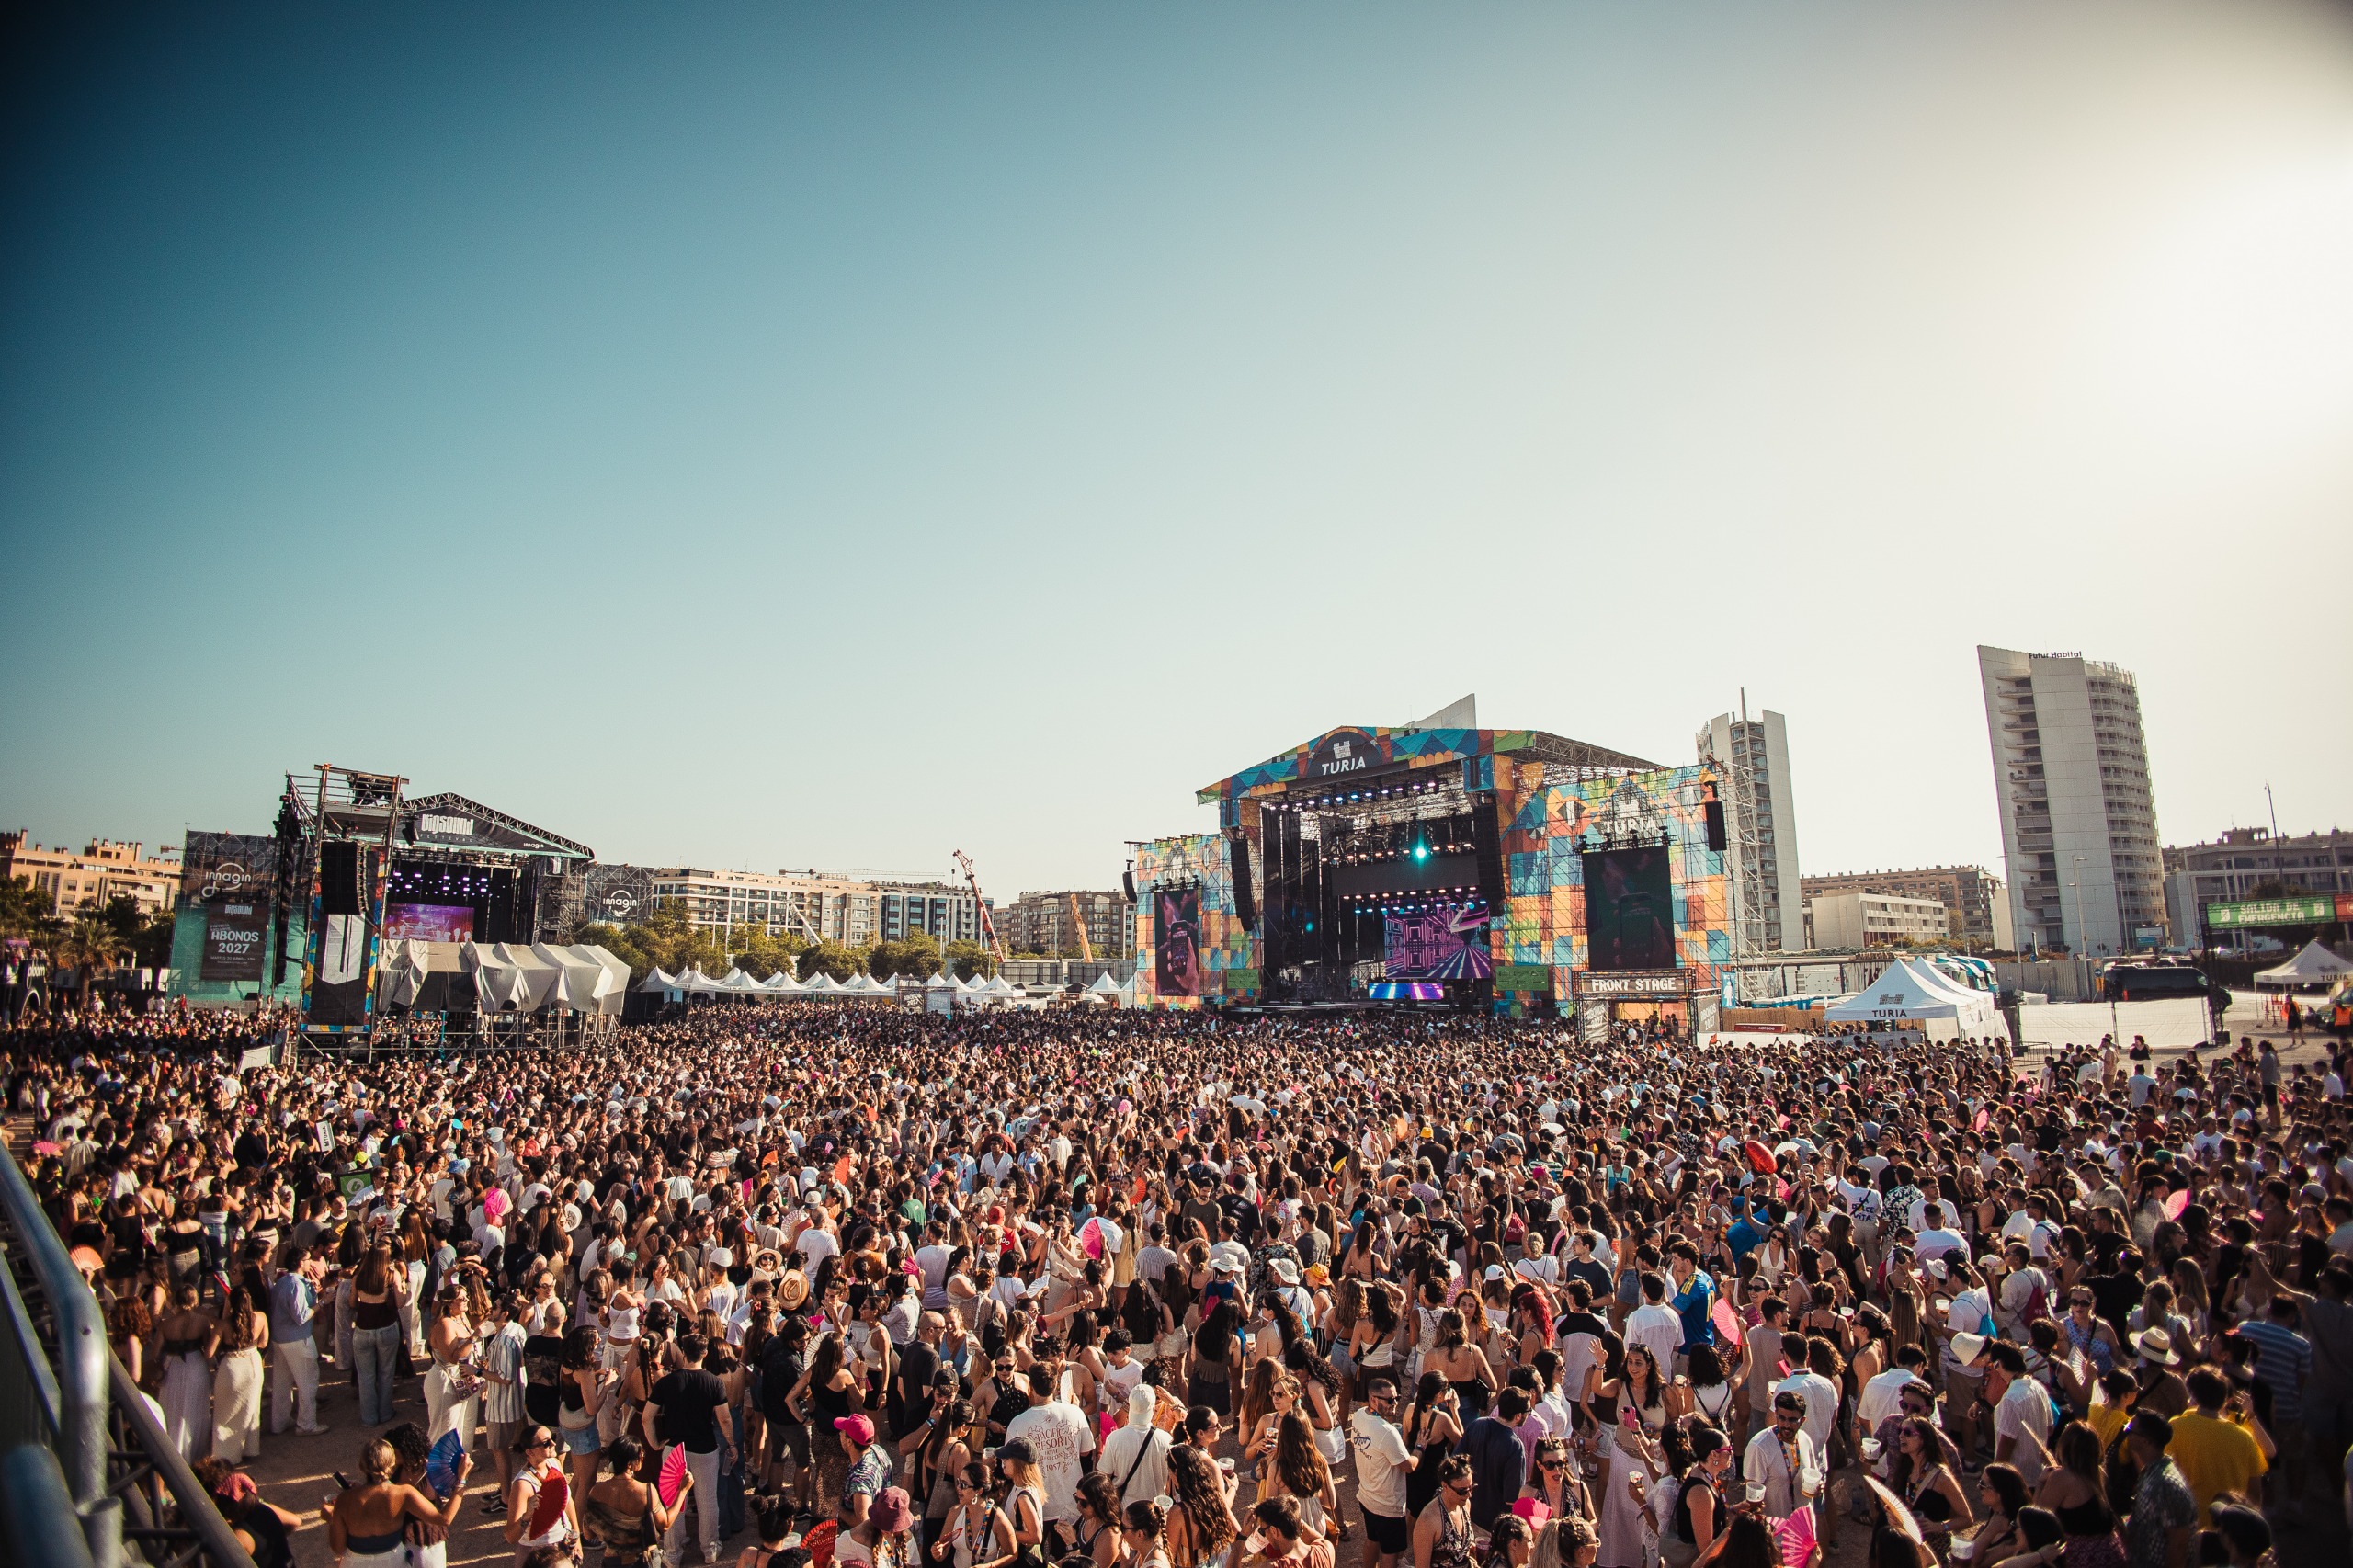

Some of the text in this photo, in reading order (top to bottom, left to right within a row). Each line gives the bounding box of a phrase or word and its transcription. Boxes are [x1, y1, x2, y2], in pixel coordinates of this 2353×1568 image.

[2051, 651, 2083, 659] Habitat
[1321, 756, 1366, 776] TURIA
[1603, 815, 1660, 834] TURIA
[205, 871, 252, 884] imagin
[1165, 868, 1191, 879] TURIA
[602, 898, 637, 909] imagin
[2240, 902, 2300, 915] SALIDA DE
[2238, 911, 2305, 923] EMERGENCIA
[218, 942, 250, 954] 2027
[1591, 977, 1677, 992] FRONT STAGE
[1871, 1009, 1907, 1018] TURIA
[1037, 1427, 1064, 1442] PACIFIC
[1035, 1436, 1074, 1451] RESORTS
[1046, 1462, 1061, 1471] 1957
